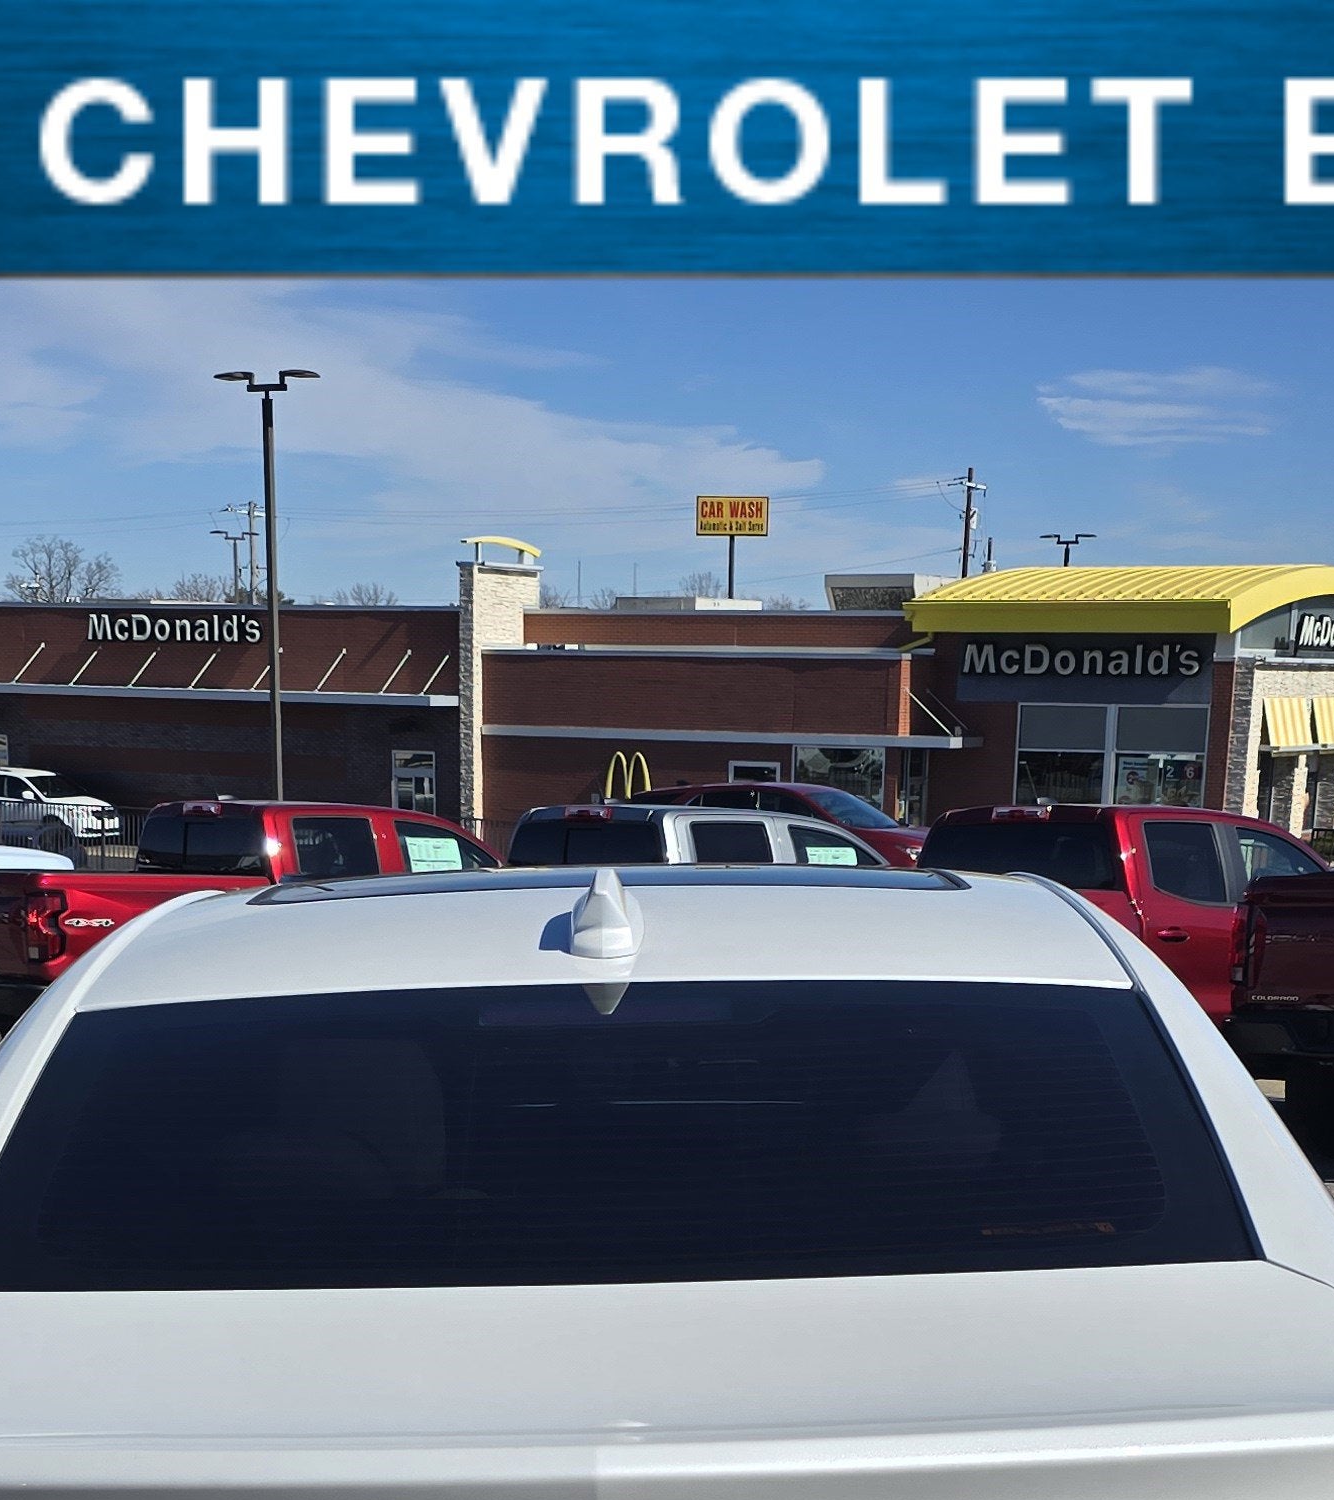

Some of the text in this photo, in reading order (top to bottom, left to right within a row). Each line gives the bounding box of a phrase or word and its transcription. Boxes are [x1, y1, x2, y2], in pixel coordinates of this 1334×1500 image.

[701, 501, 763, 518] CAR WASH
[87, 613, 261, 643] McDonald's
[962, 643, 1201, 677] McDonald's
